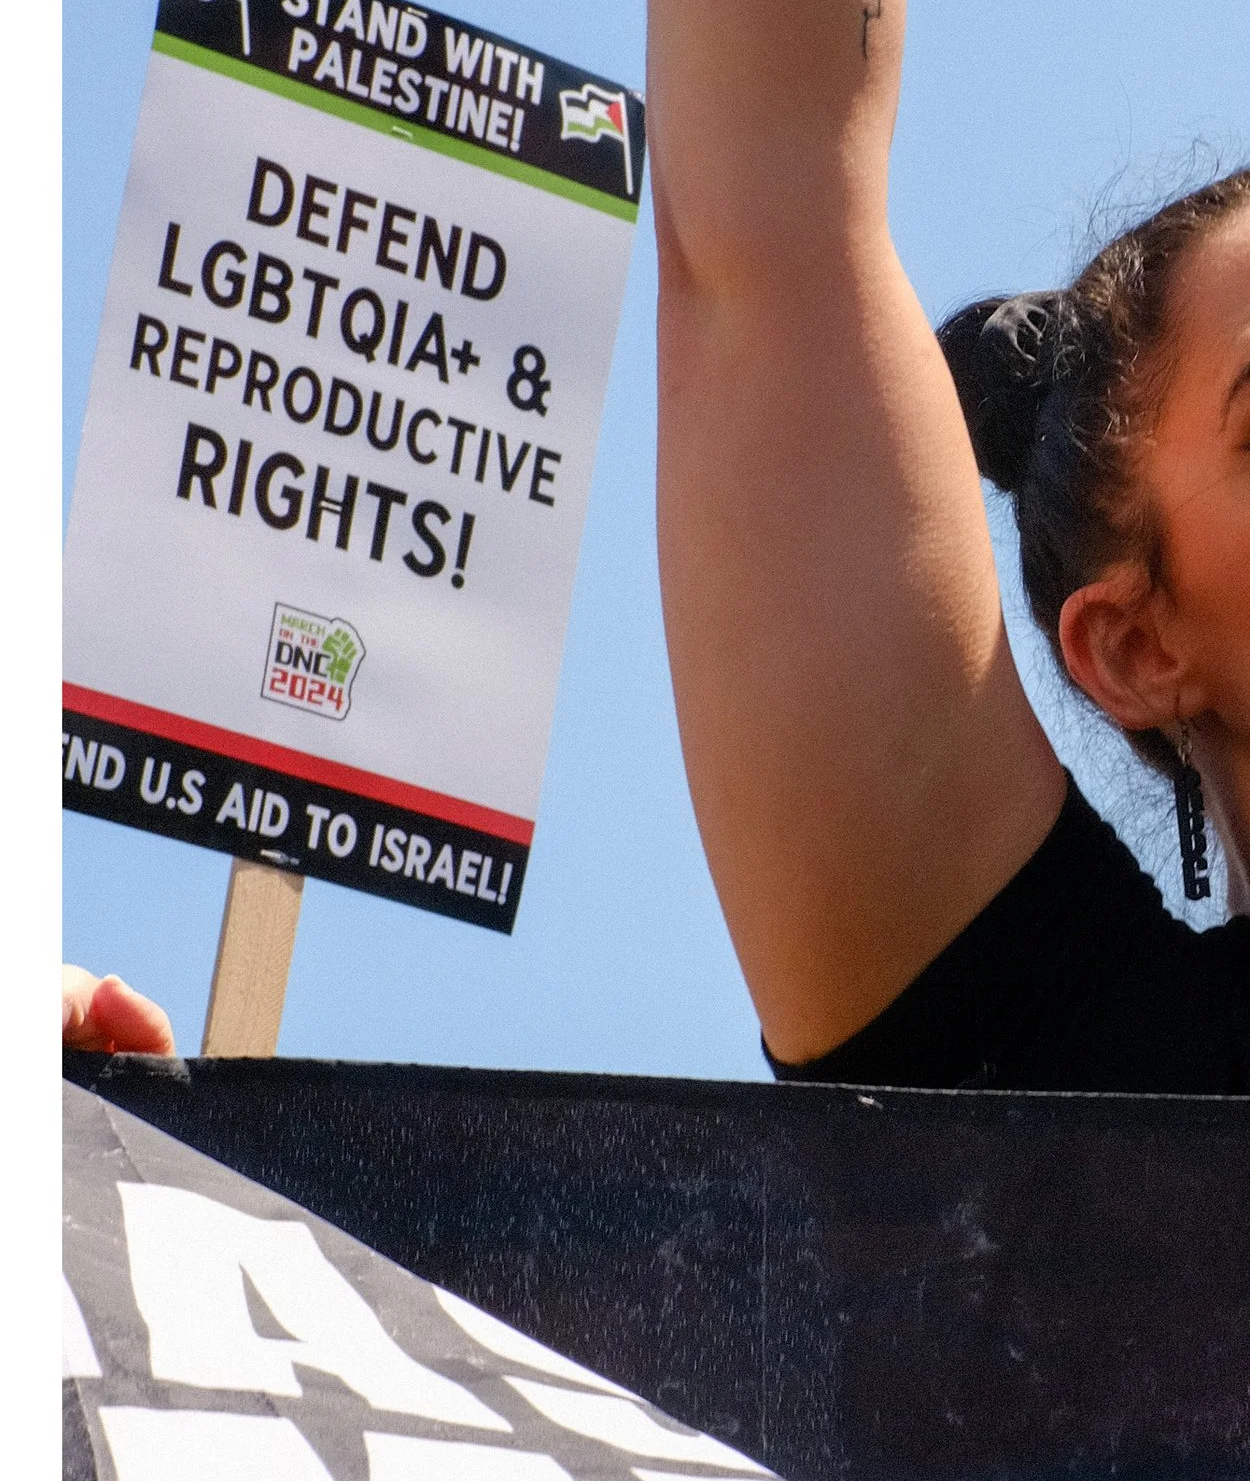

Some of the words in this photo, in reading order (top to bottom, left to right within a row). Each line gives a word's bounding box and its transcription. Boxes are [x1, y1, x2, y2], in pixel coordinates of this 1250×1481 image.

[287, 27, 525, 152] PALESTINE!
[444, 26, 545, 106] WITH
[246, 156, 507, 302] DEFEND
[157, 221, 481, 385] LGBTQIA+
[506, 344, 551, 417] &
[129, 313, 562, 507] REPRODUCTIVE
[176, 422, 476, 589] RIGHTS!
[269, 666, 344, 712] 2024
[275, 640, 331, 678] DNC
[62, 733, 126, 792] ND
[139, 756, 206, 815] U.S
[215, 781, 290, 838] AID
[306, 803, 358, 858] TO
[369, 824, 513, 906] ISRAEL!
